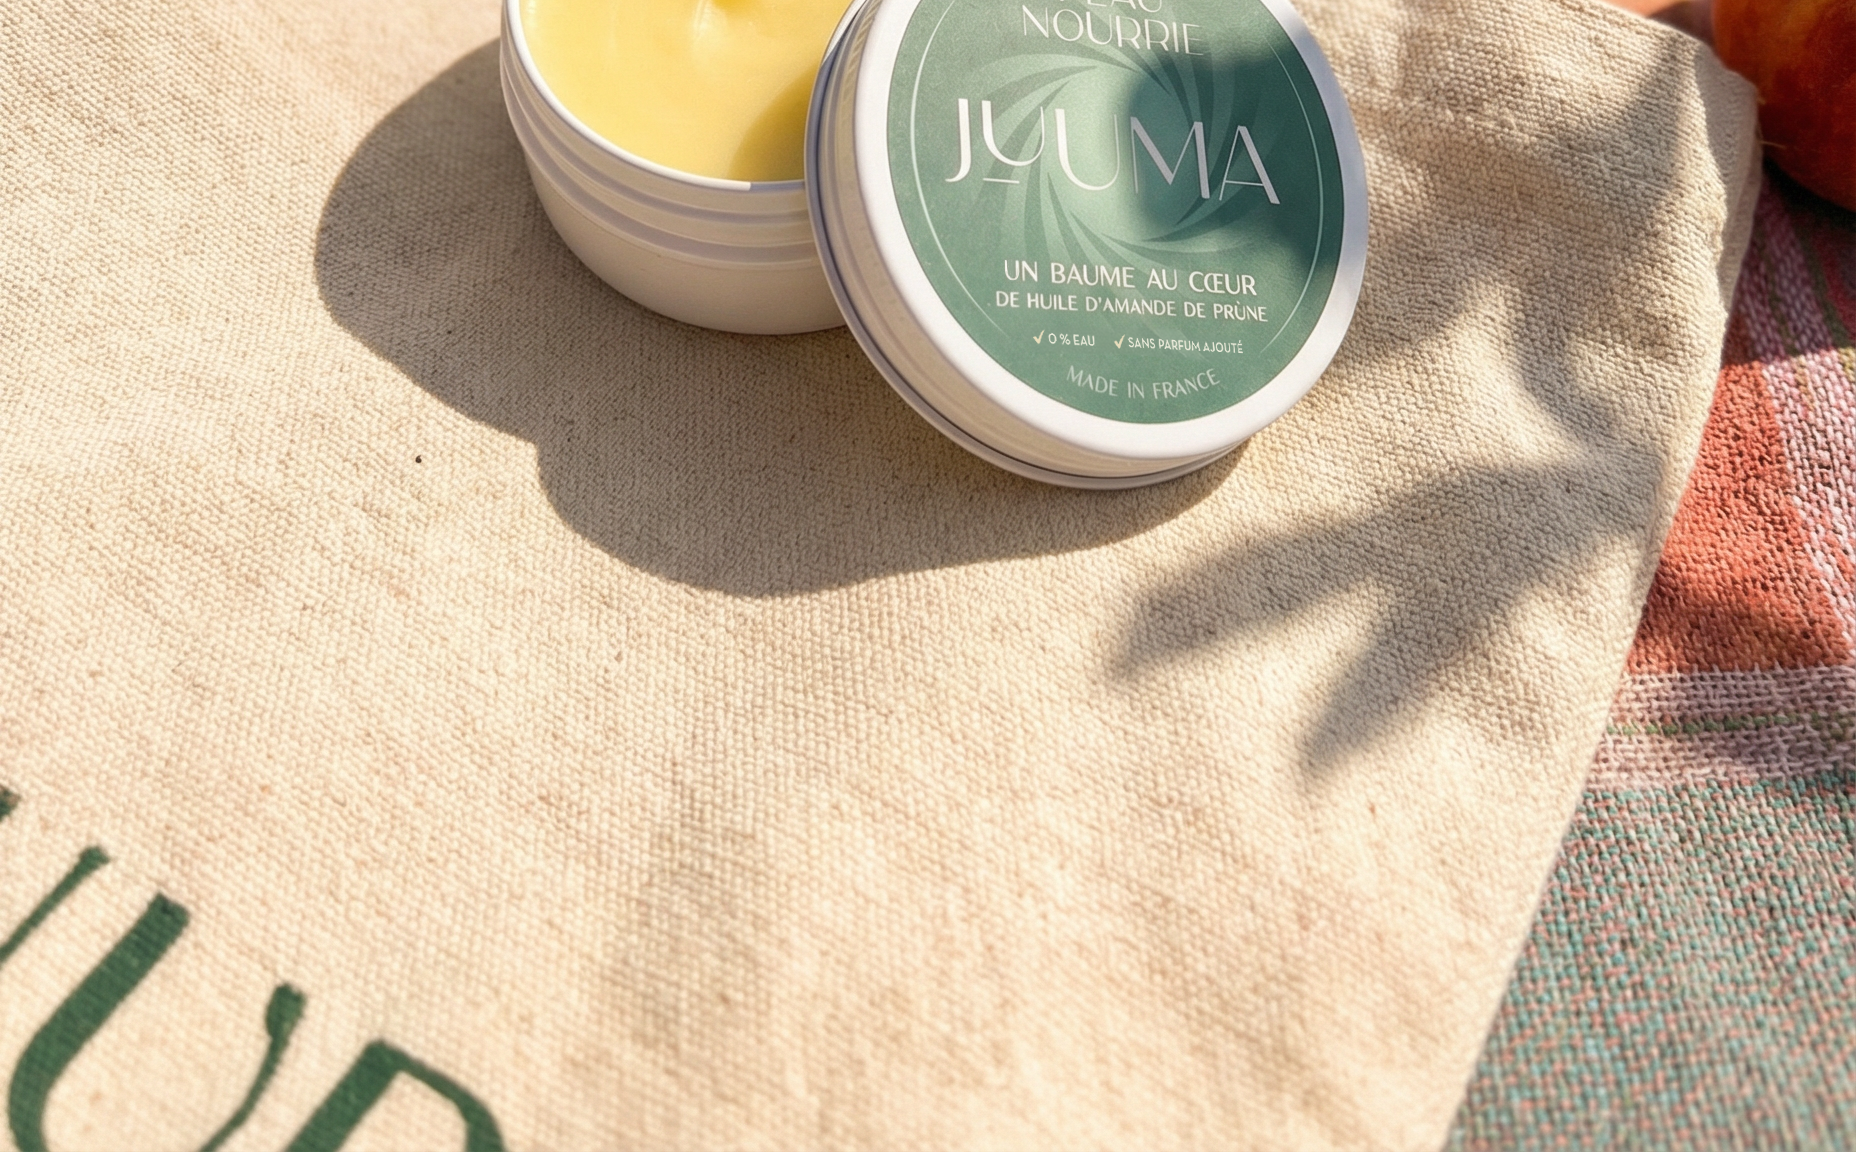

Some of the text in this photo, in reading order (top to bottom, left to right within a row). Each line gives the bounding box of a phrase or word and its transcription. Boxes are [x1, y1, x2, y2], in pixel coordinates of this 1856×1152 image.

[1021, 4, 1204, 56] NOURRIE
[1004, 259, 1257, 296] UN BAUME AU CŒUR
[995, 290, 1020, 308] DE
[1026, 292, 1079, 311] HUILE
[1085, 295, 1177, 317] D'AMANDE
[1183, 301, 1206, 319] DE
[1073, 334, 1095, 347] EAU
[1127, 336, 1244, 354] SANS PARFUM AJOUTÉ
[1066, 364, 1221, 400] MADE IN FRANCE
